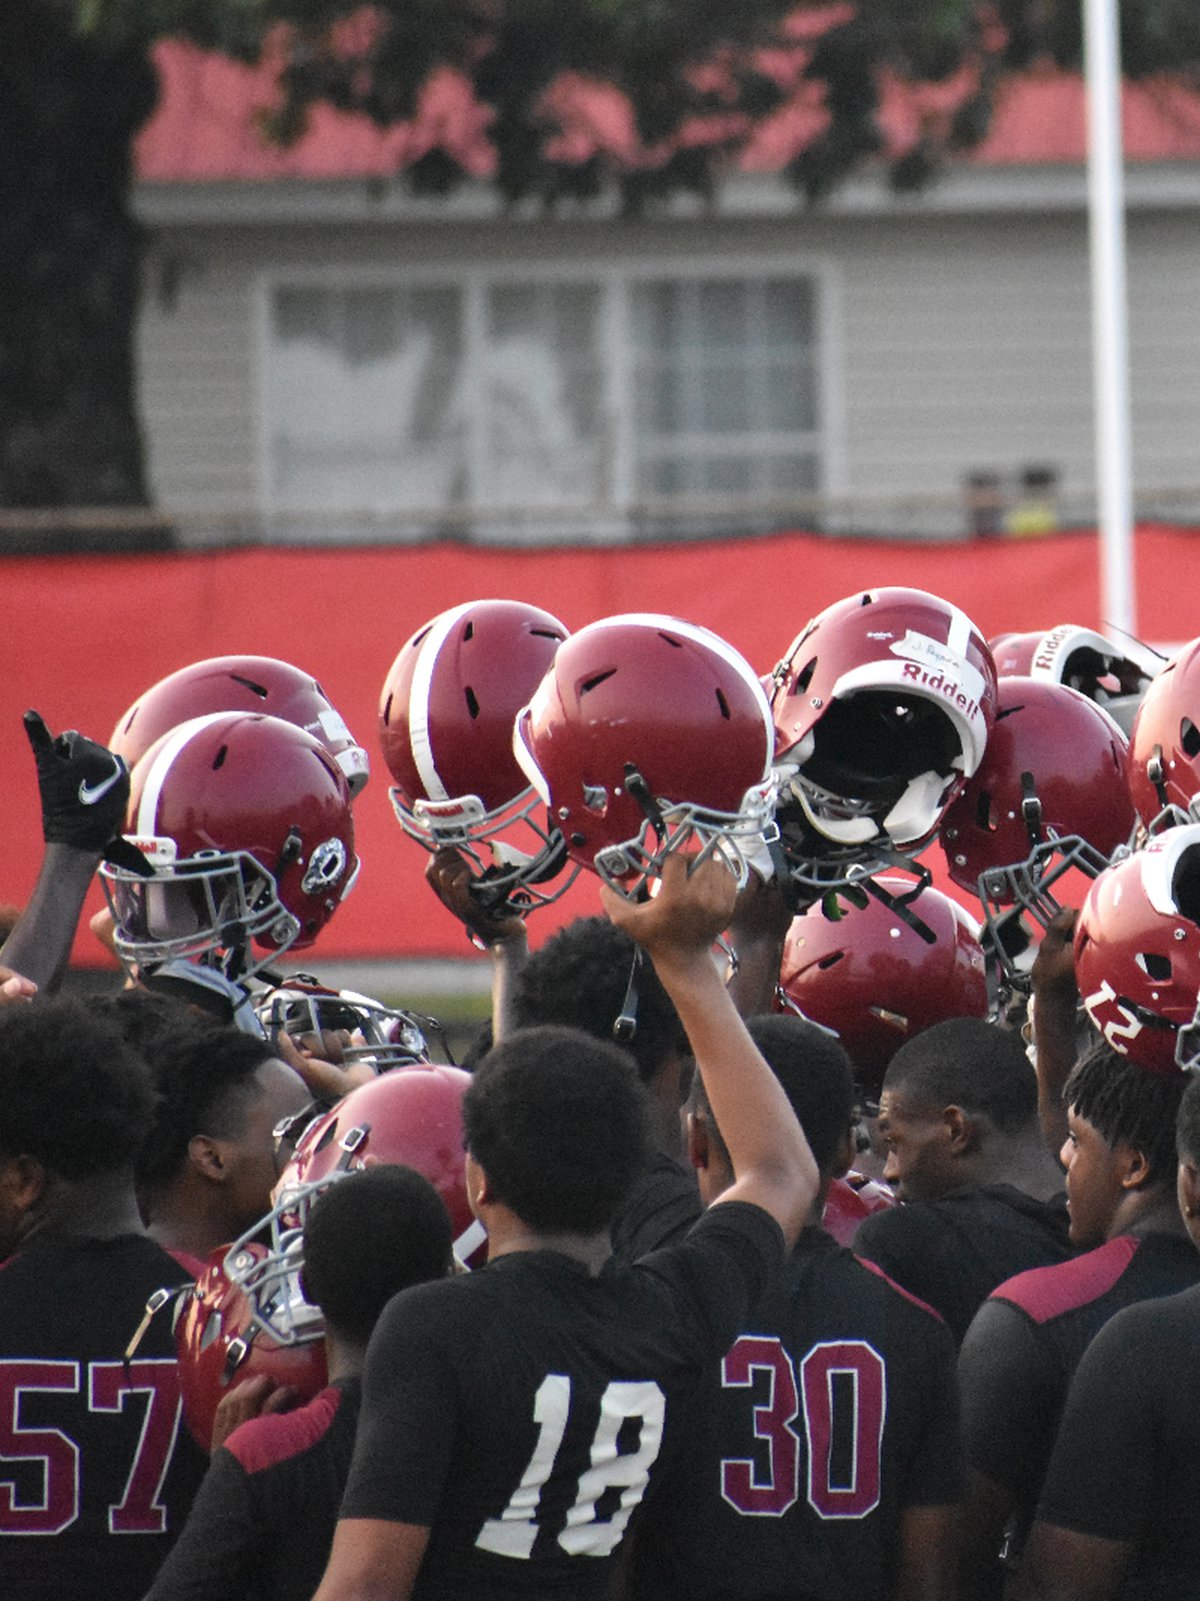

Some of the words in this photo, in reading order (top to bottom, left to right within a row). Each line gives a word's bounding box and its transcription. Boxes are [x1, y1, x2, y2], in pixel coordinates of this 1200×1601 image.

[902, 662, 980, 721] Riddell
[1083, 979, 1144, 1055] 12
[0, 1358, 183, 1537] 57
[475, 1373, 667, 1560] 18
[720, 1335, 887, 1520] 30
